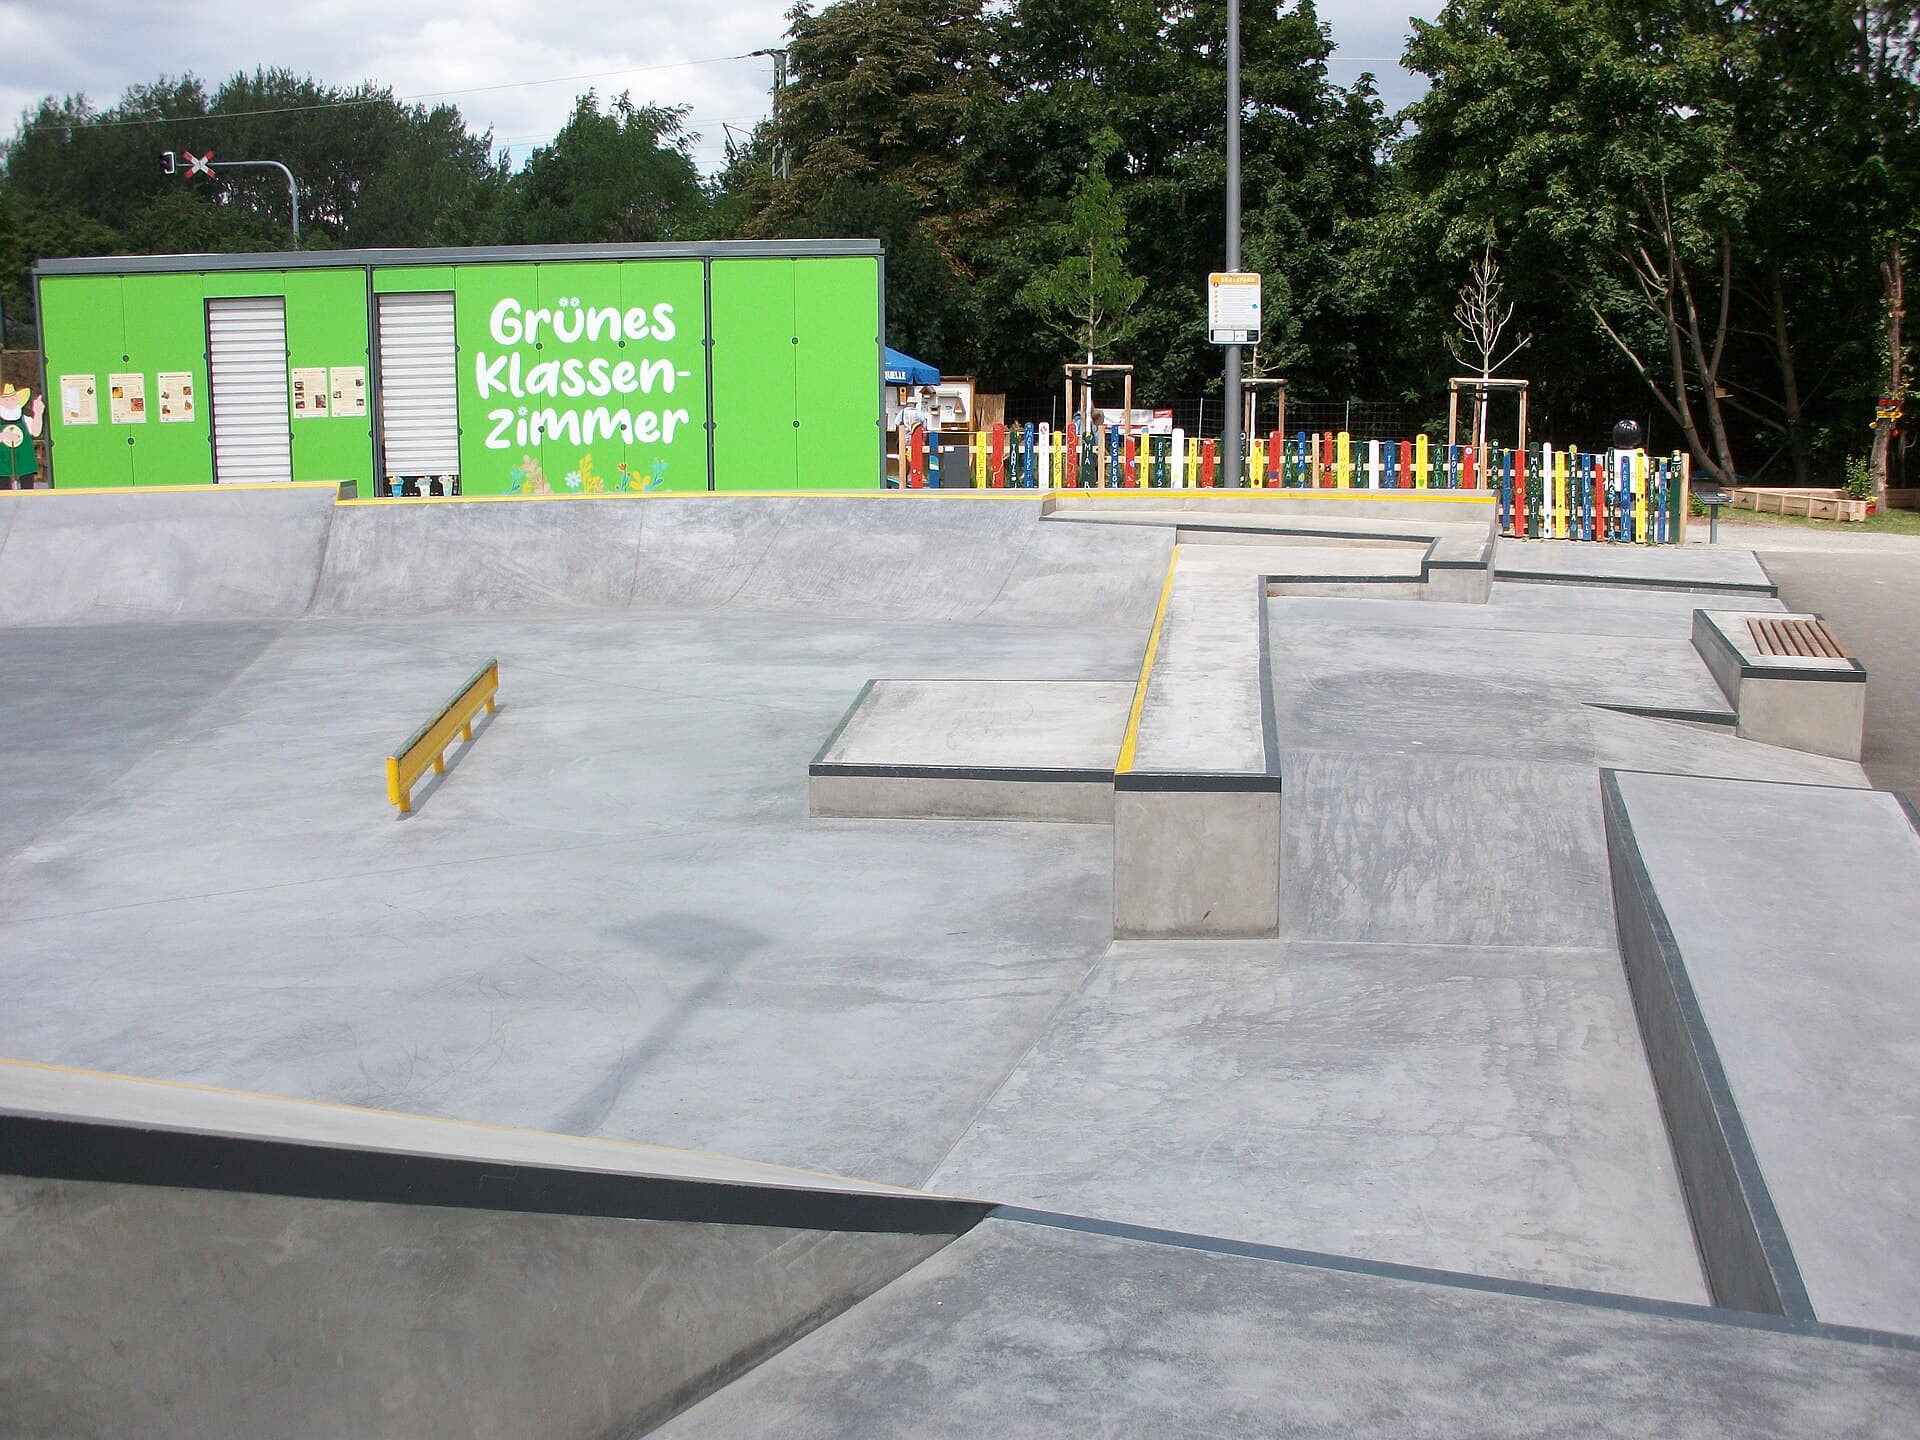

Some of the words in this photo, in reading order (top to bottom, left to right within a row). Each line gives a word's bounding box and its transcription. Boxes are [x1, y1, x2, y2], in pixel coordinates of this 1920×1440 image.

[490, 297, 676, 345] Grünes
[475, 351, 691, 400] Klassen-
[1530, 456, 1538, 479] MAX
